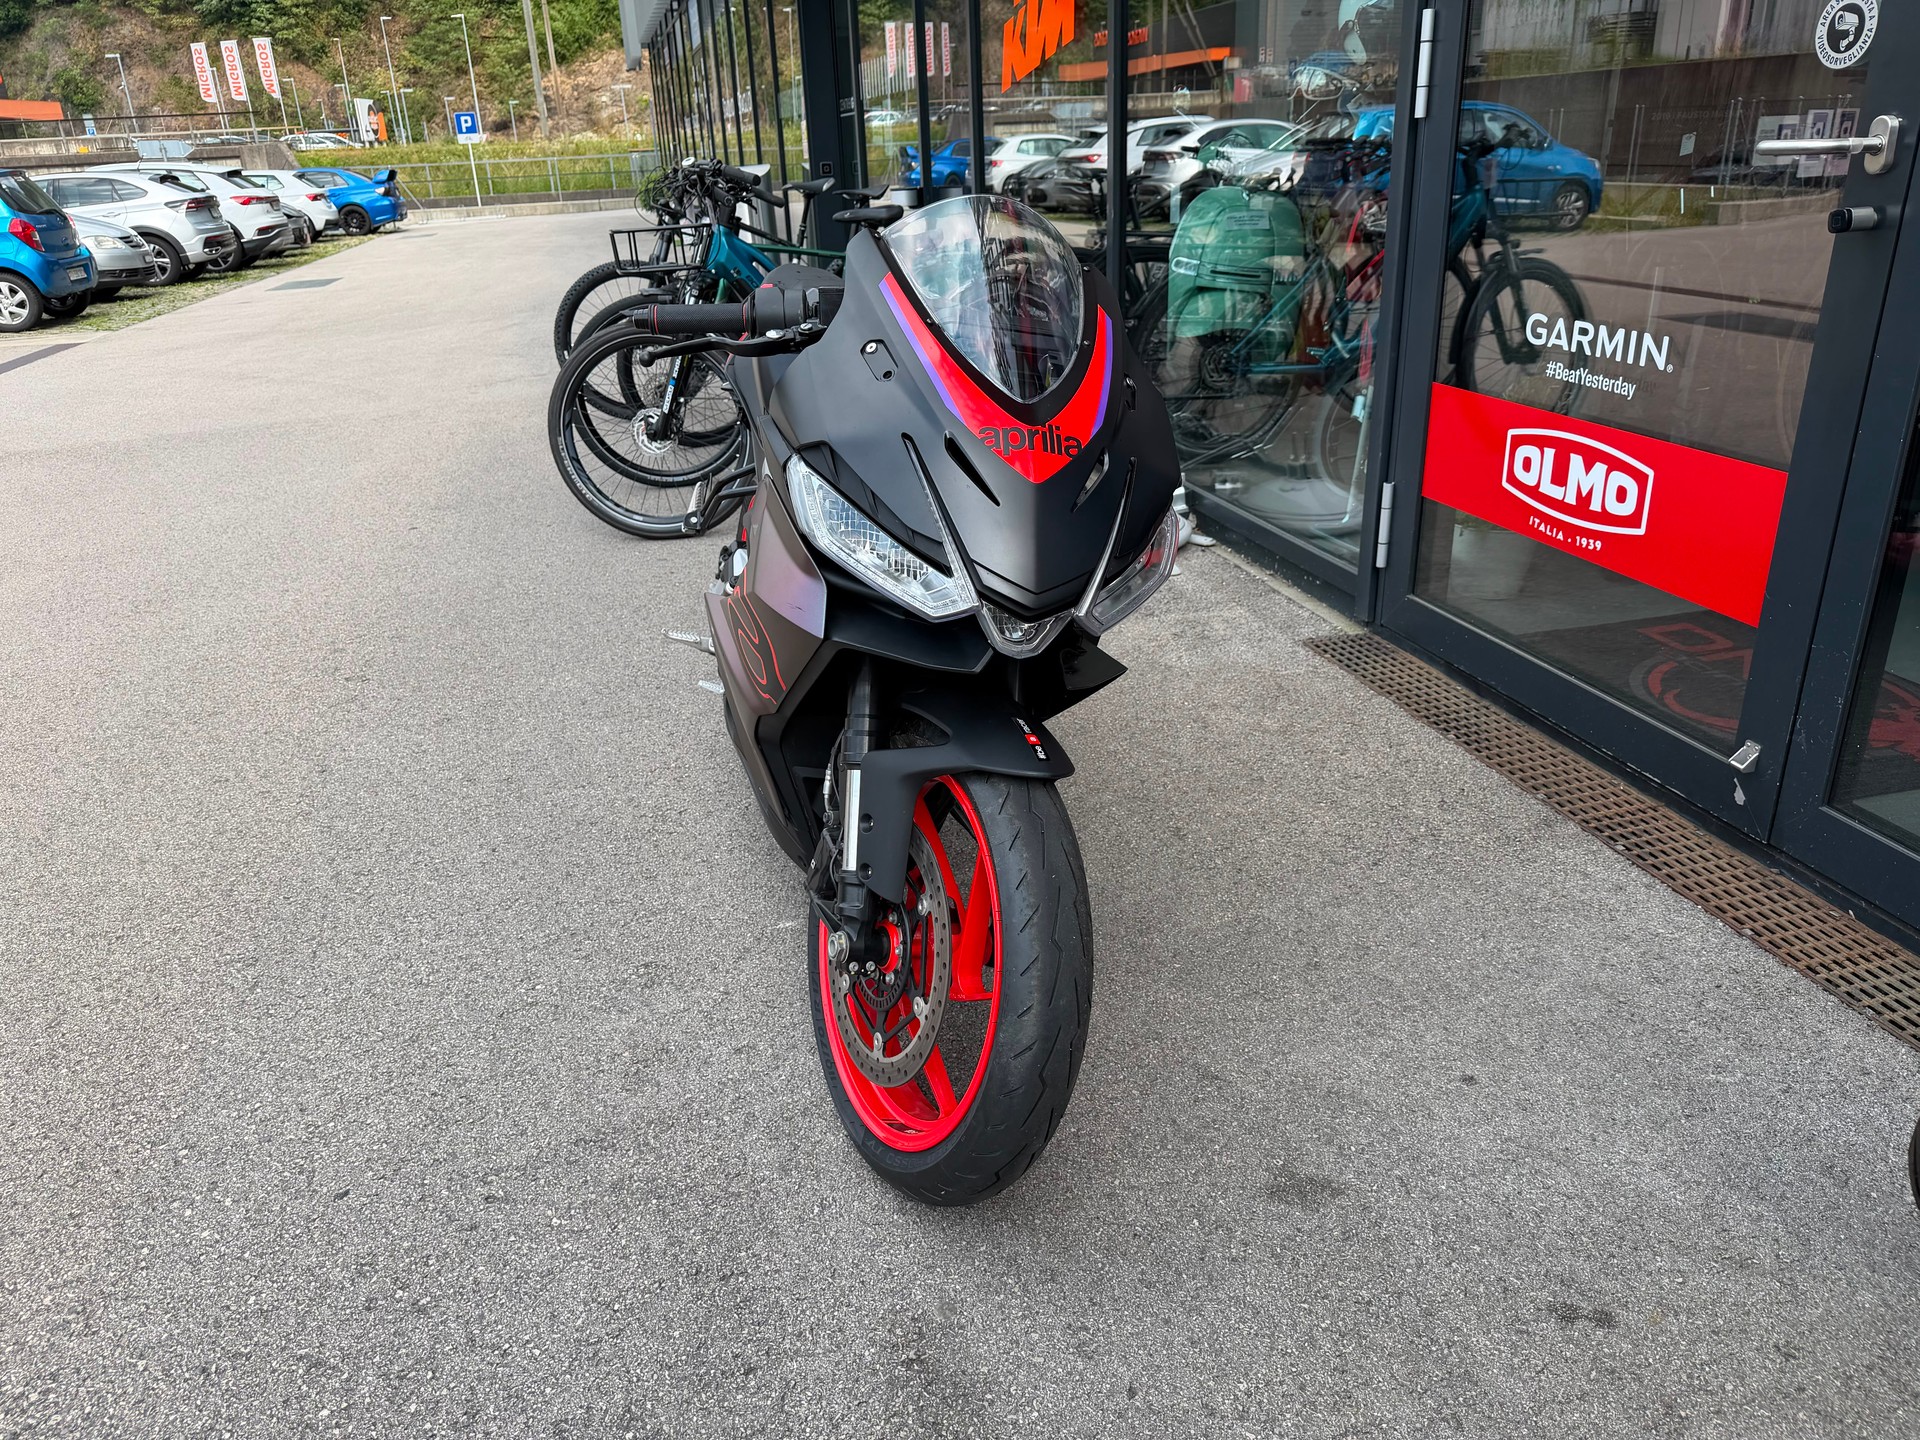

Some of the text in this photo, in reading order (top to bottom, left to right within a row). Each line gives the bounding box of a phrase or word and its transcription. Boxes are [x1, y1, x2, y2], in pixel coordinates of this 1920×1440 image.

[1820, 4, 1836, 27] AREA
[1001, 0, 1075, 94] KTM
[1817, 27, 1874, 66] VIDEOSORVEGLIANZA
[460, 115, 472, 133] P
[1525, 312, 1670, 371] GARMIN
[1545, 360, 1636, 400] #BeatYesterday
[979, 424, 1083, 459] aprilia
[1513, 444, 1639, 517] OLMO
[1528, 516, 1602, 551] ITALIA 1939
